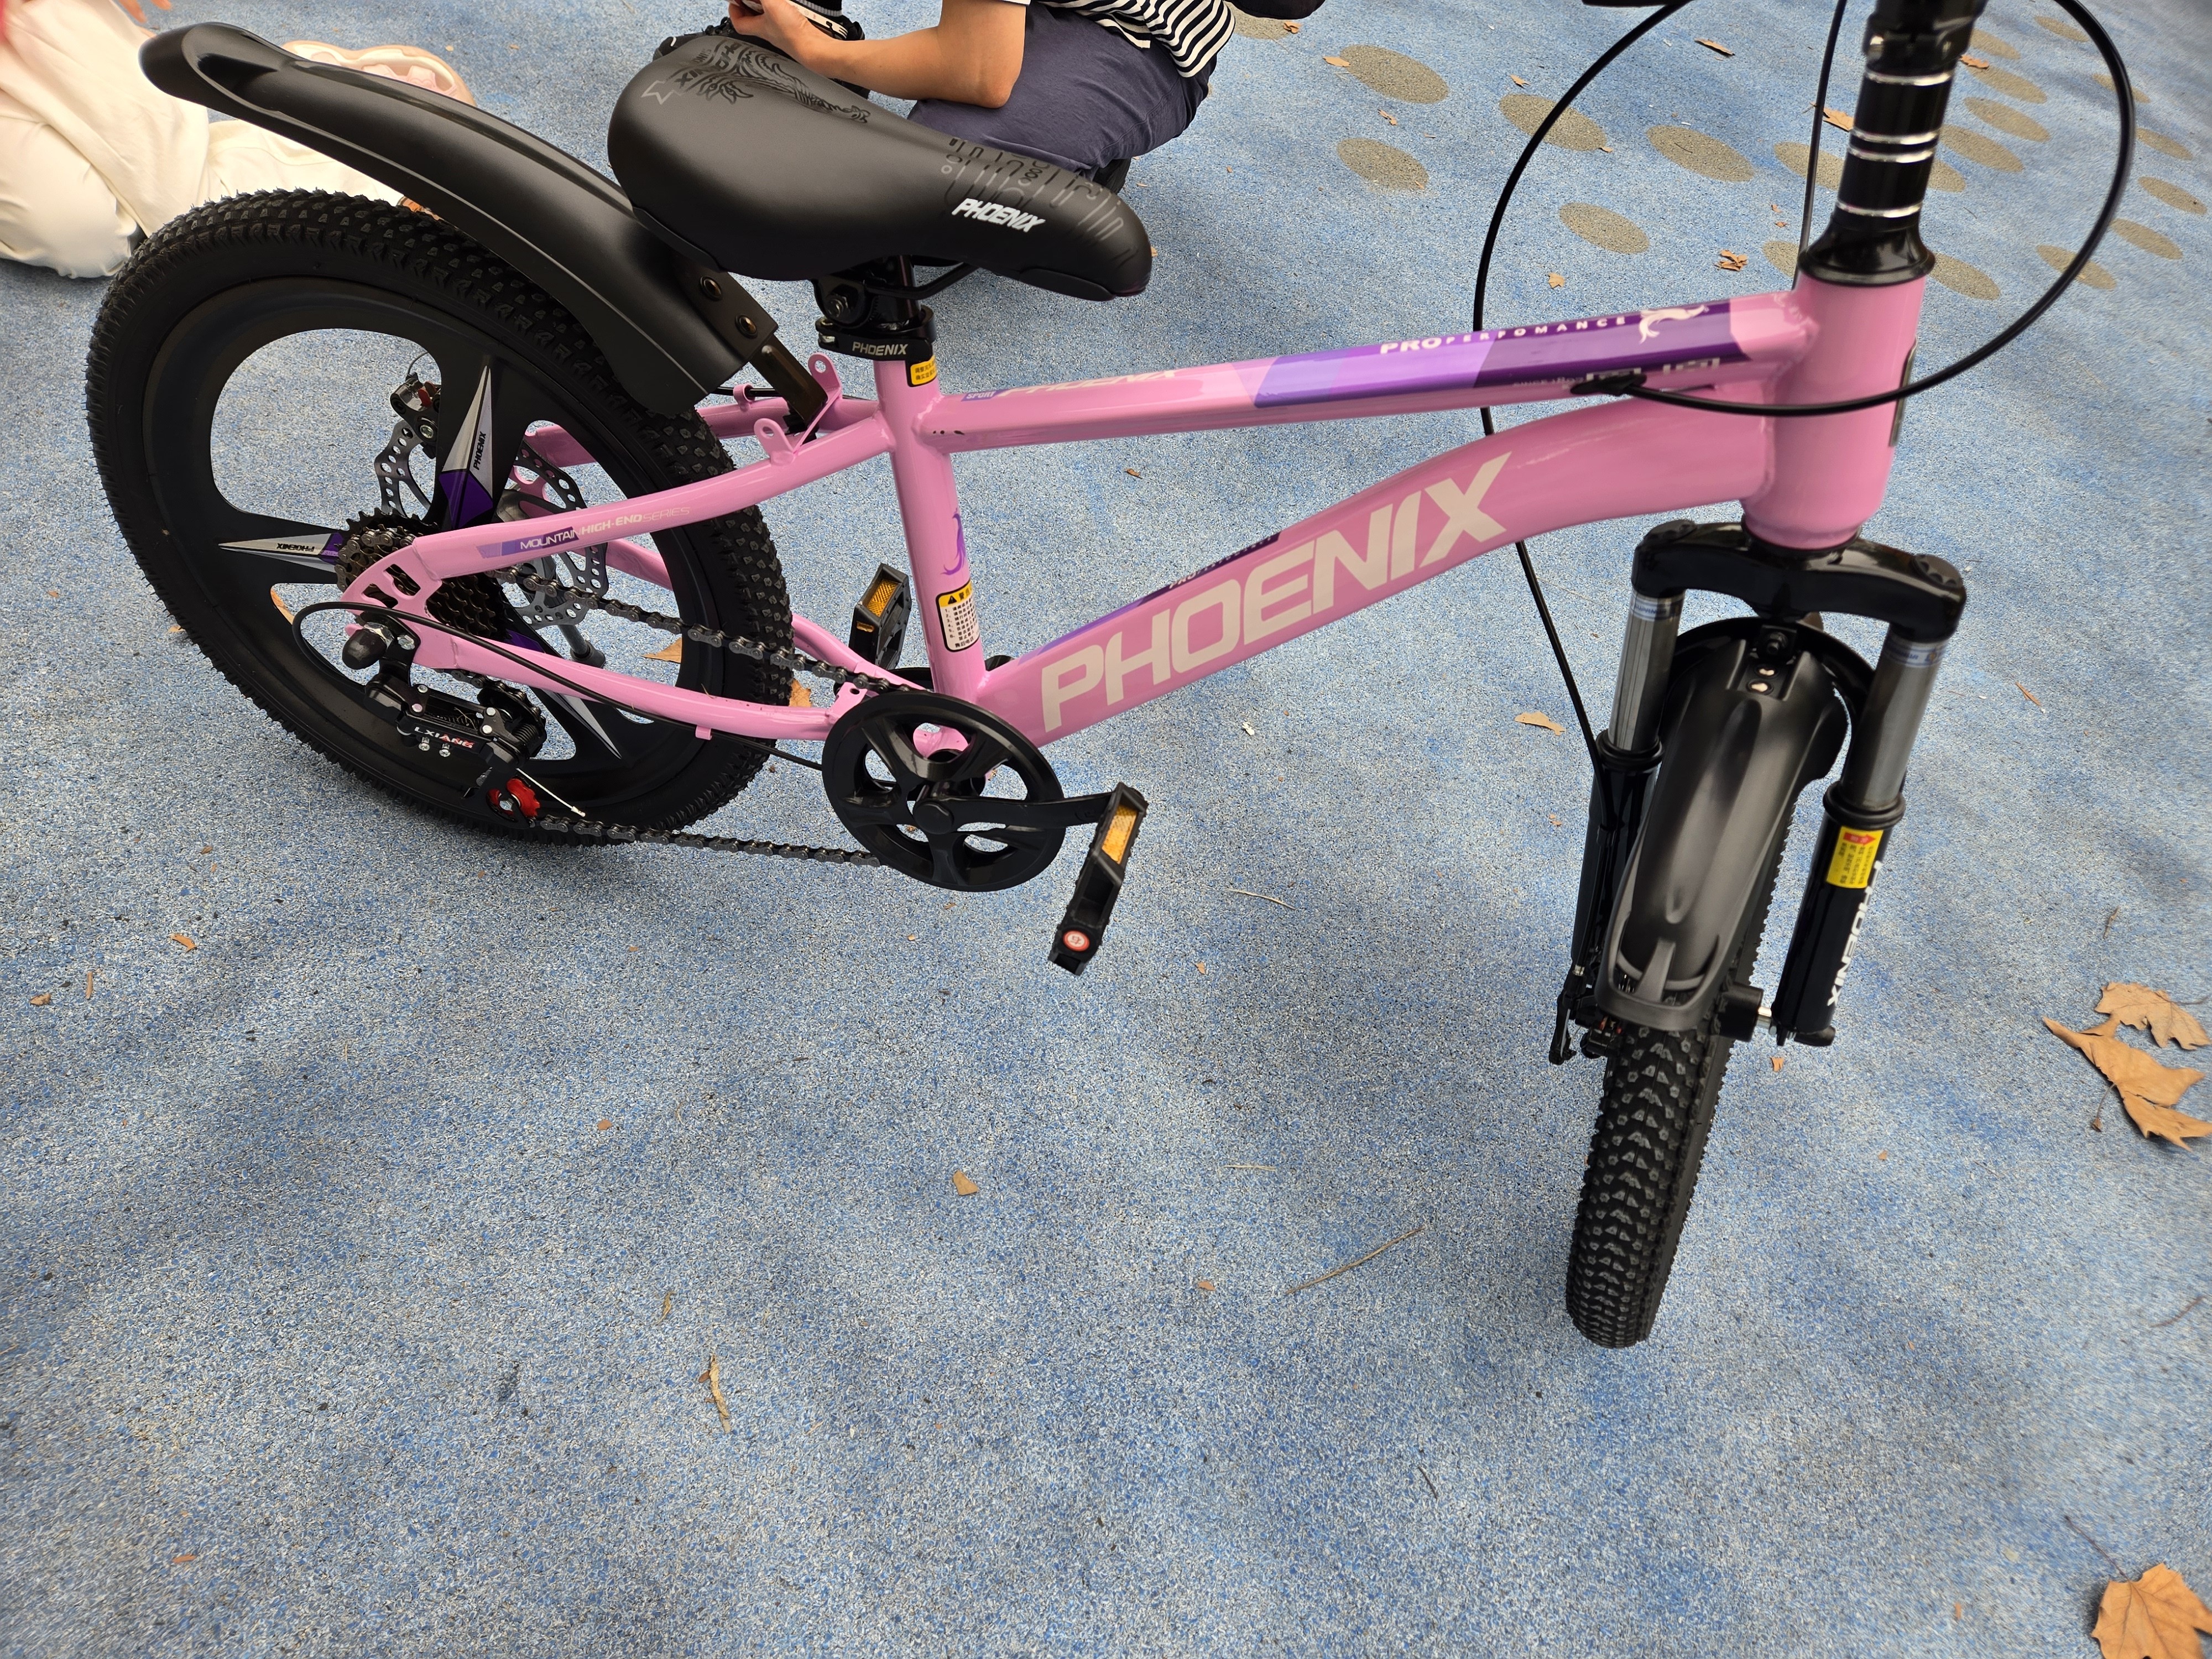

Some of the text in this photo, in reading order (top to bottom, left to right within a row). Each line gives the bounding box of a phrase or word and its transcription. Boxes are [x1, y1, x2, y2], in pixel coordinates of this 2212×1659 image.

[952, 198, 1046, 232] PHOENIX
[852, 341, 908, 356] PHOENIX
[1380, 316, 1626, 354] PRO PERFOMANCE
[966, 390, 996, 399] SPORT
[473, 431, 486, 471] PHOENIX
[520, 507, 691, 550] MOUNTAIN HIGH-END SERIES
[276, 543, 315, 552] PHOENIX
[1041, 451, 1512, 733] PHOENIX
[415, 727, 475, 749] LXIANG
